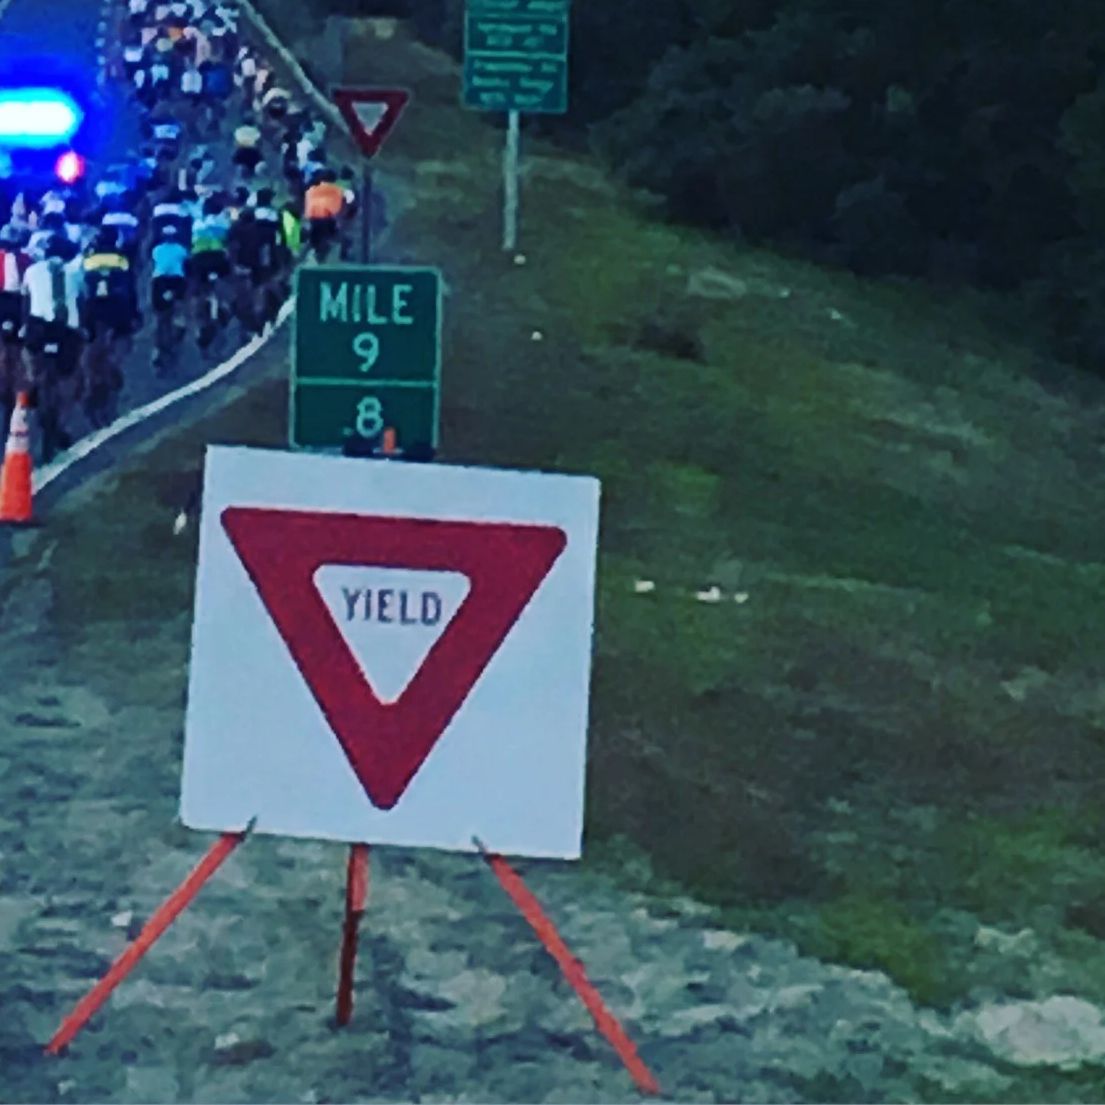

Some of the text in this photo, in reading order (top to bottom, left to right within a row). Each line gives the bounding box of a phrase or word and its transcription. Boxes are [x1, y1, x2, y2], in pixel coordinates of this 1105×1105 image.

[319, 281, 414, 325] MILE
[352, 332, 380, 373] 9
[341, 586, 442, 626] YIELD
